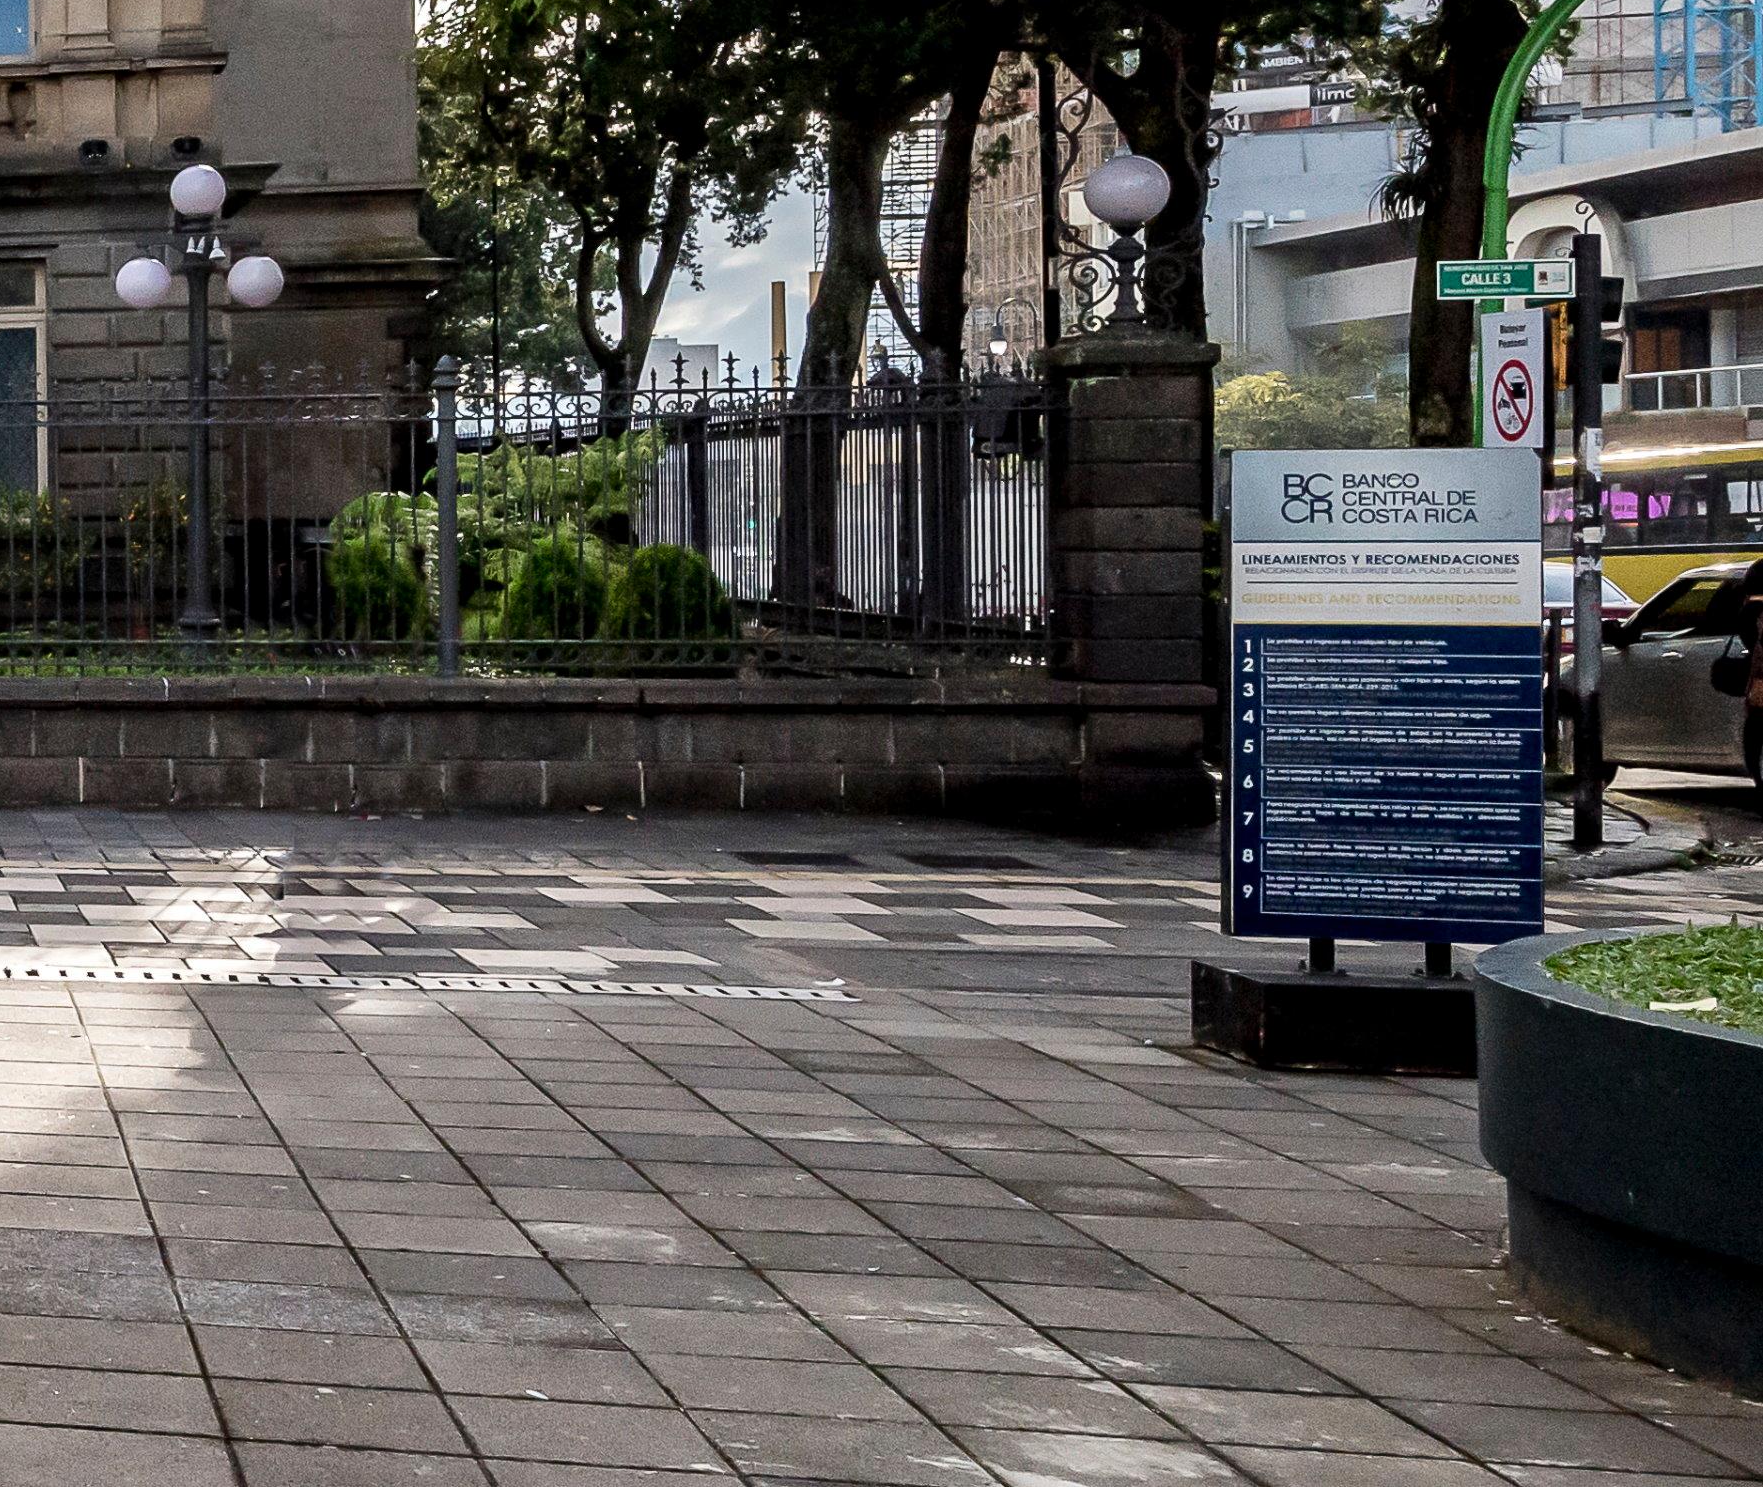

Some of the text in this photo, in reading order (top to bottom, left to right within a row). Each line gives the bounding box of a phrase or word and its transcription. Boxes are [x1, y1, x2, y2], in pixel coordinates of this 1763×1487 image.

[1461, 272, 1511, 285] CALLE 3
[1342, 474, 1419, 488] BANCO
[1342, 491, 1476, 506] CENTRAL DE
[1342, 509, 1478, 523] COSTA RICA
[1242, 554, 1520, 565] LINEAMIENTOS Y RECOMENDACIONES
[1242, 593, 1521, 605] GUIDELINES AND RECOMMENDATIONS
[1244, 639, 1251, 653] 1
[1243, 658, 1254, 672] 2
[1243, 683, 1255, 697] 3
[1242, 710, 1255, 724] 4
[1243, 740, 1254, 753] 5
[1243, 775, 1254, 788] 6
[1243, 812, 1254, 825] 7
[1242, 849, 1254, 862] 8
[1242, 885, 1253, 899] 9
